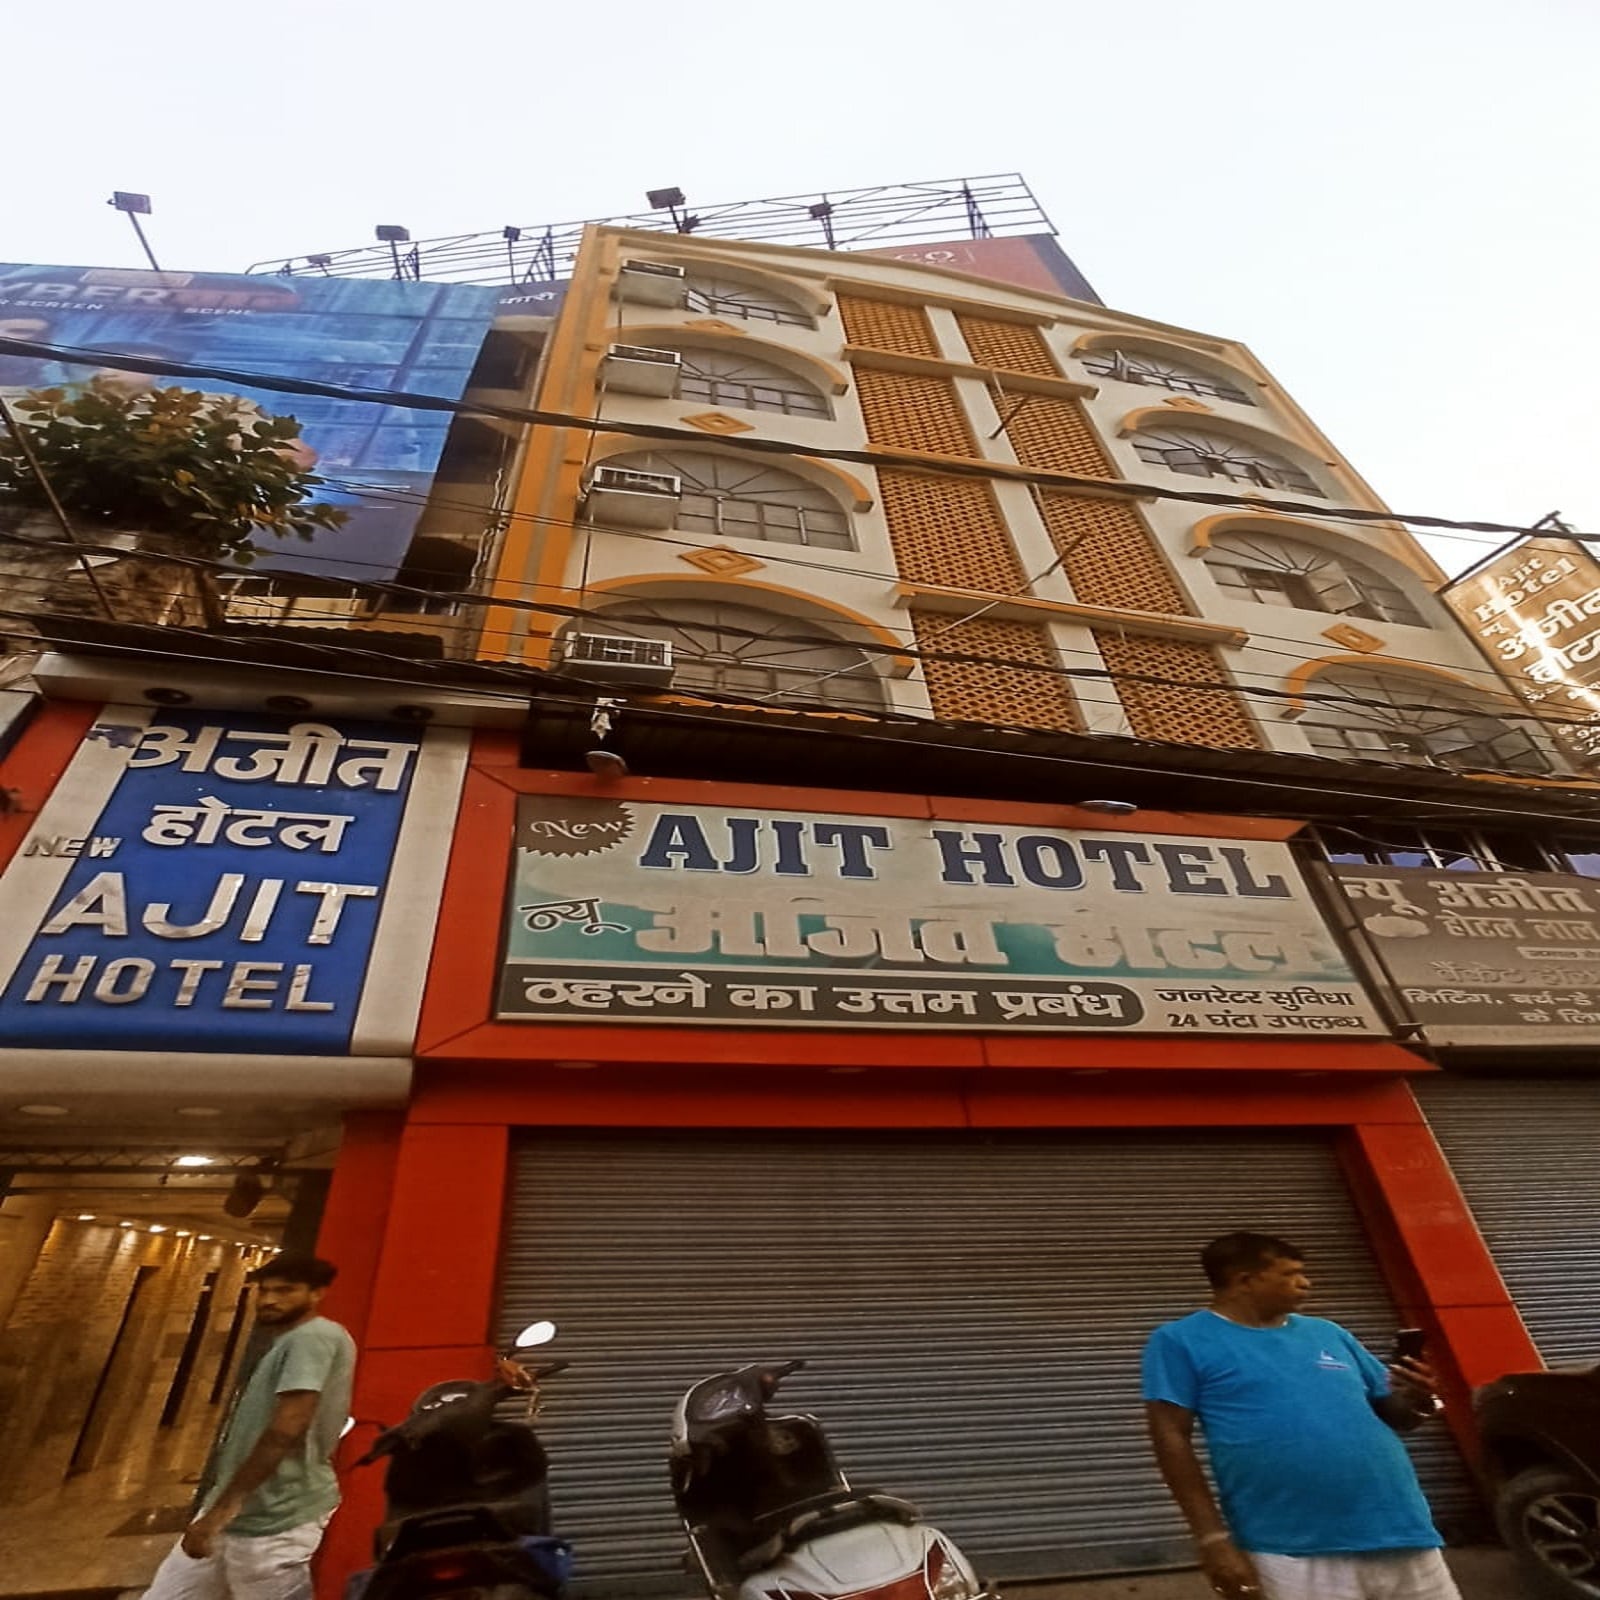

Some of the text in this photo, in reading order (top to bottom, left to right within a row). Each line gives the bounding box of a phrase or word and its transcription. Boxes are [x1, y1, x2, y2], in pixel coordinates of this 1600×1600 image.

[1474, 557, 1577, 622] Hotel
[1499, 558, 1544, 590] Ajit
[124, 722, 420, 792] अजीत
[141, 795, 356, 852] होटल
[530, 817, 624, 840] New
[23, 834, 121, 858] NEW
[638, 812, 1294, 900] AJIT HOTEL
[39, 870, 379, 946] AJIT
[518, 896, 631, 936] न्यू
[1337, 875, 1597, 917] न्यू अजीत
[1434, 909, 1529, 939] होटल
[24, 953, 335, 1012] HOTEL
[522, 973, 1123, 1021] ठहरने का उत्तम प्रबंध
[1154, 985, 1356, 1011] जनरेटर सुविधा
[1167, 1010, 1369, 1030] 24 घंटा उपलब्ध
[1518, 1008, 1552, 1023] के
